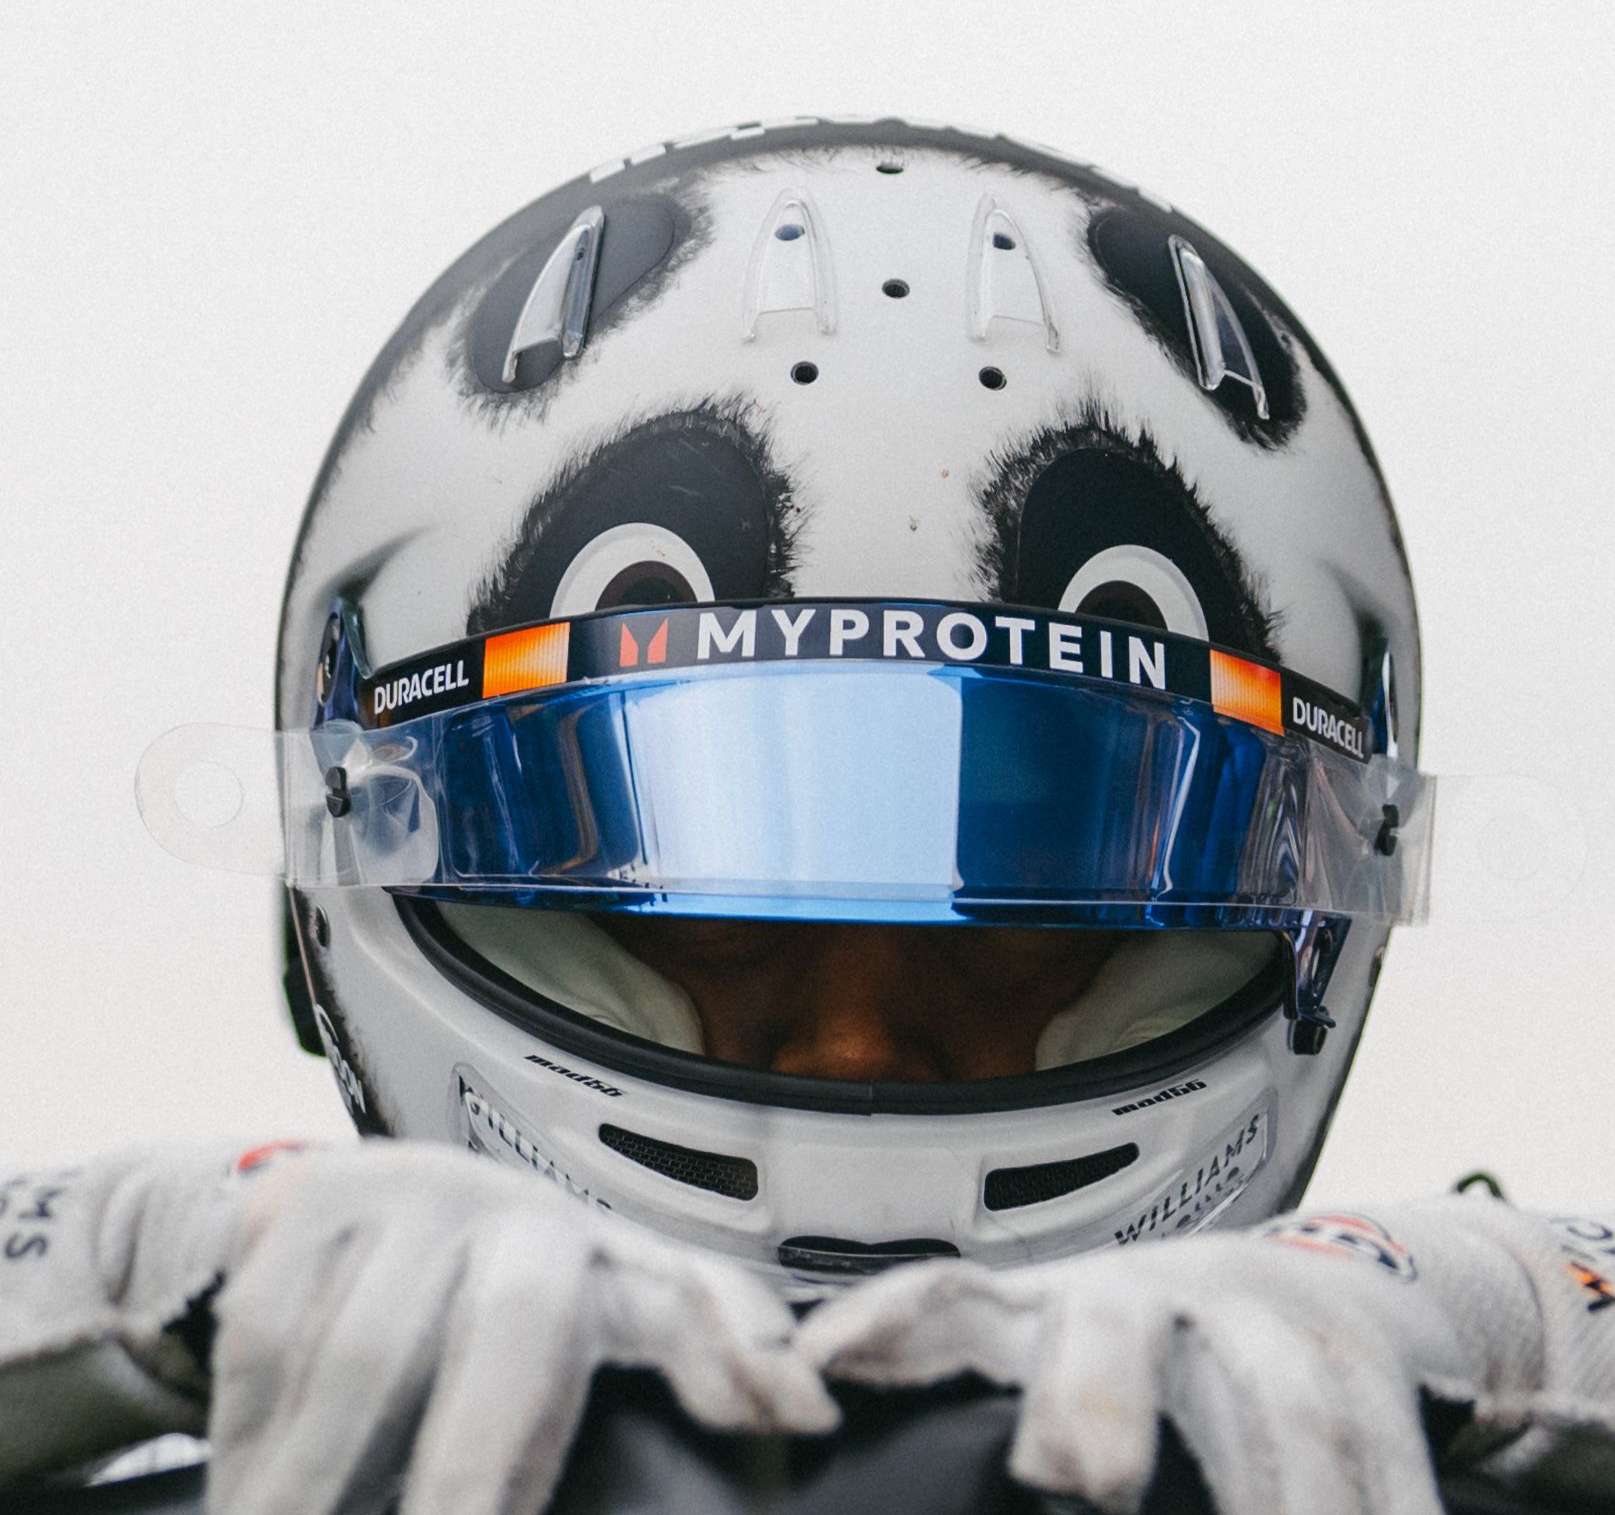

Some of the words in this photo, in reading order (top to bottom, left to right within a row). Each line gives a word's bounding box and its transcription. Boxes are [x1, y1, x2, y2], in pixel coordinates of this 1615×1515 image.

[697, 607, 1167, 690] MYPROTEIN
[374, 660, 469, 714] DURACELL
[1292, 696, 1365, 759] DURACELL
[1114, 1113, 1259, 1245] WILLIAMS
